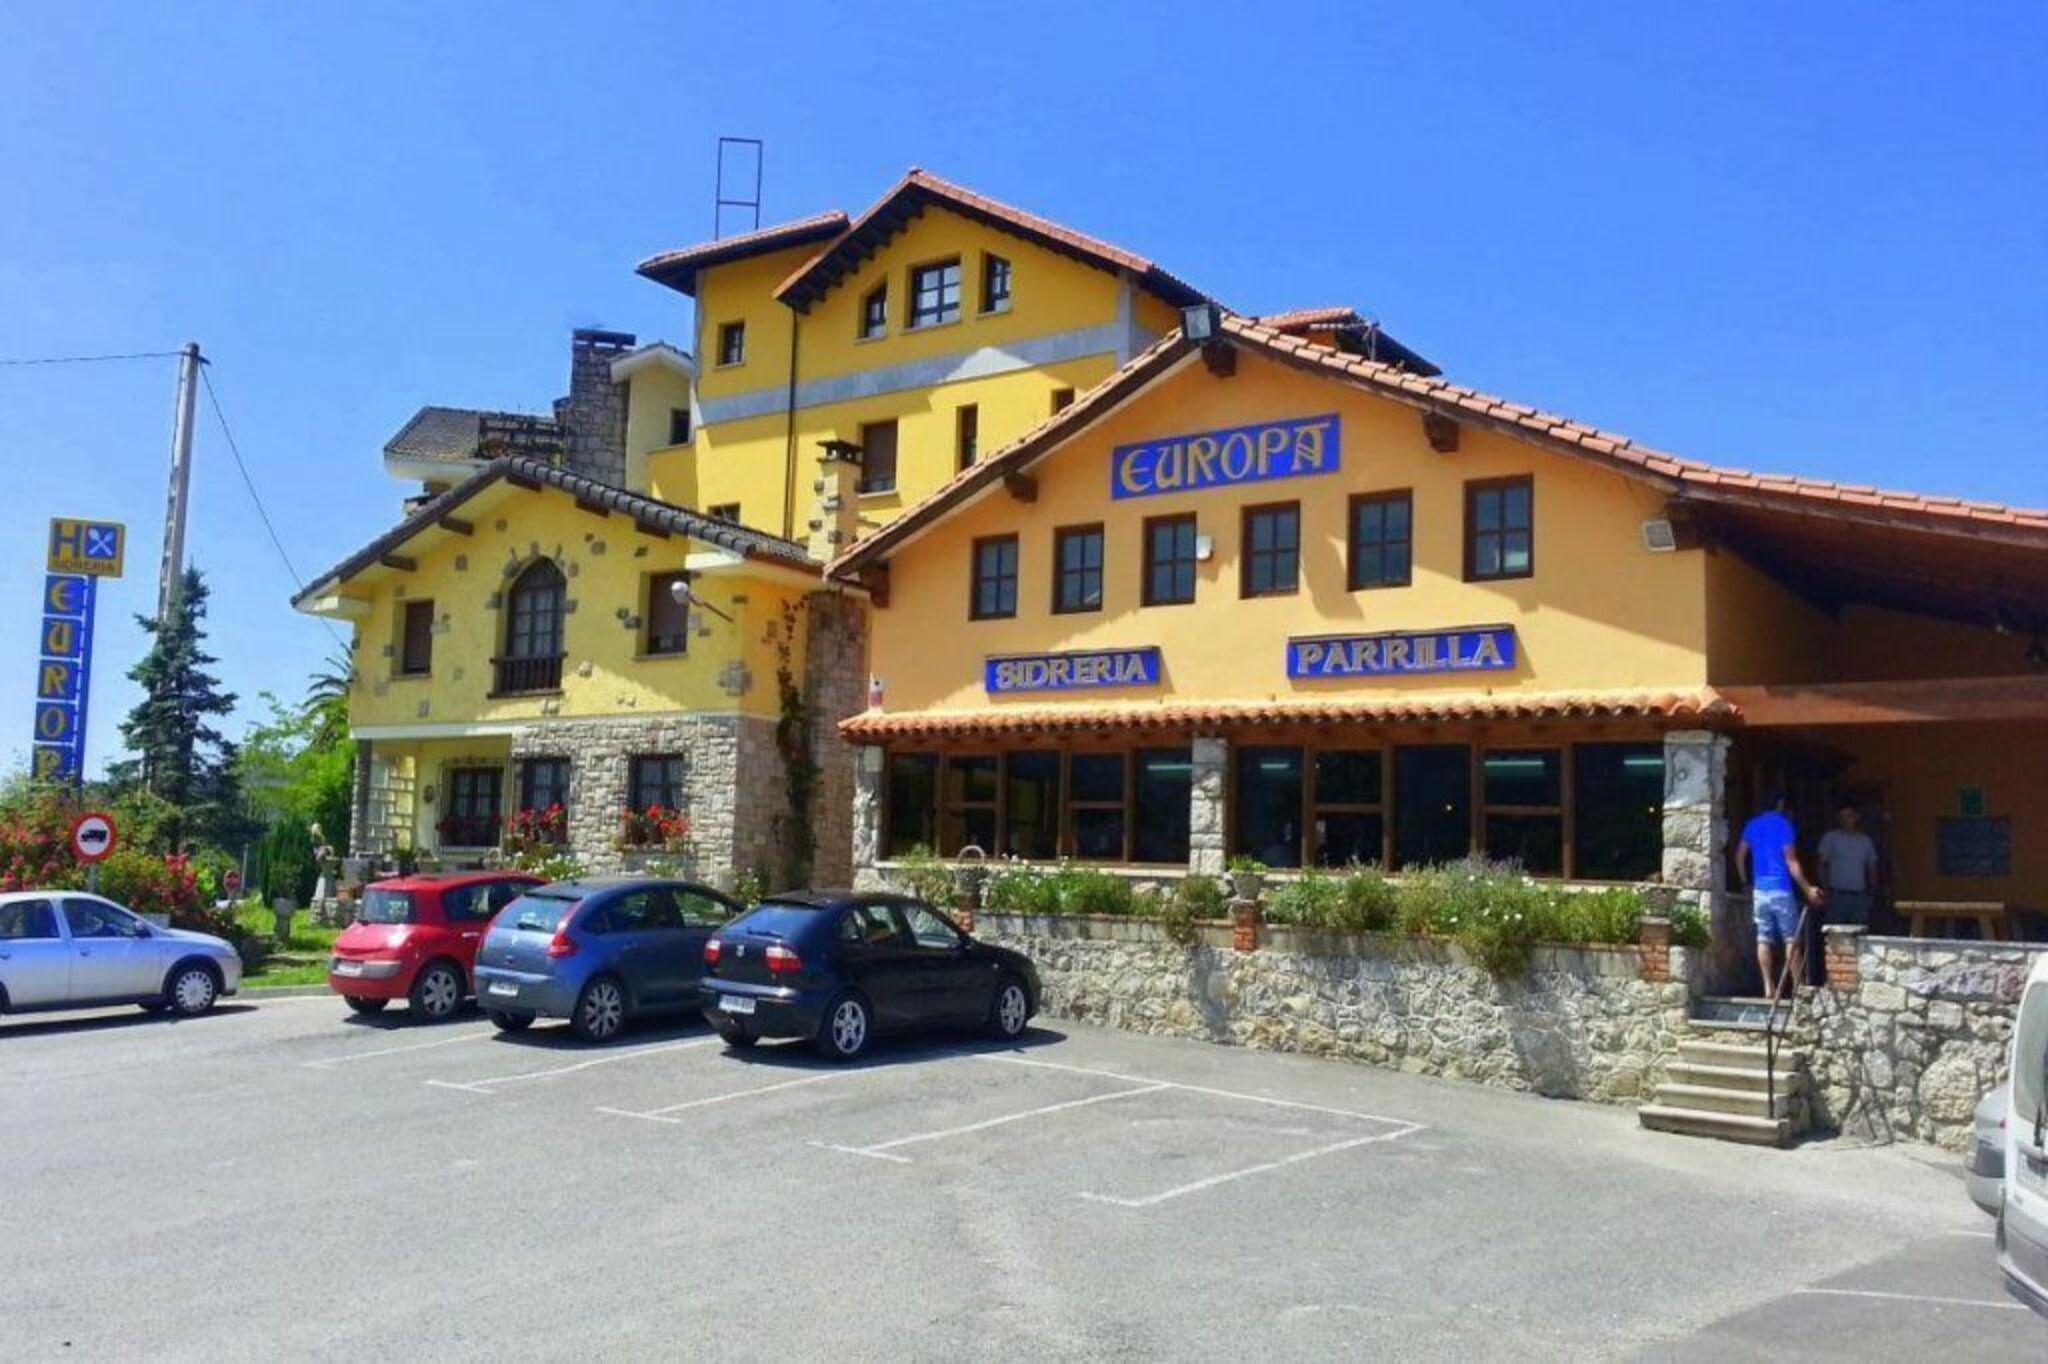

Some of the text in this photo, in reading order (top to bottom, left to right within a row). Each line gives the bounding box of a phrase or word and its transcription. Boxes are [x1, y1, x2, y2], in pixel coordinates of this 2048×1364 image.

[1119, 421, 1331, 493] EUROPA
[53, 521, 82, 557] H
[995, 653, 1148, 689] SIDRERIA
[1297, 633, 1505, 675] PARRILLA
